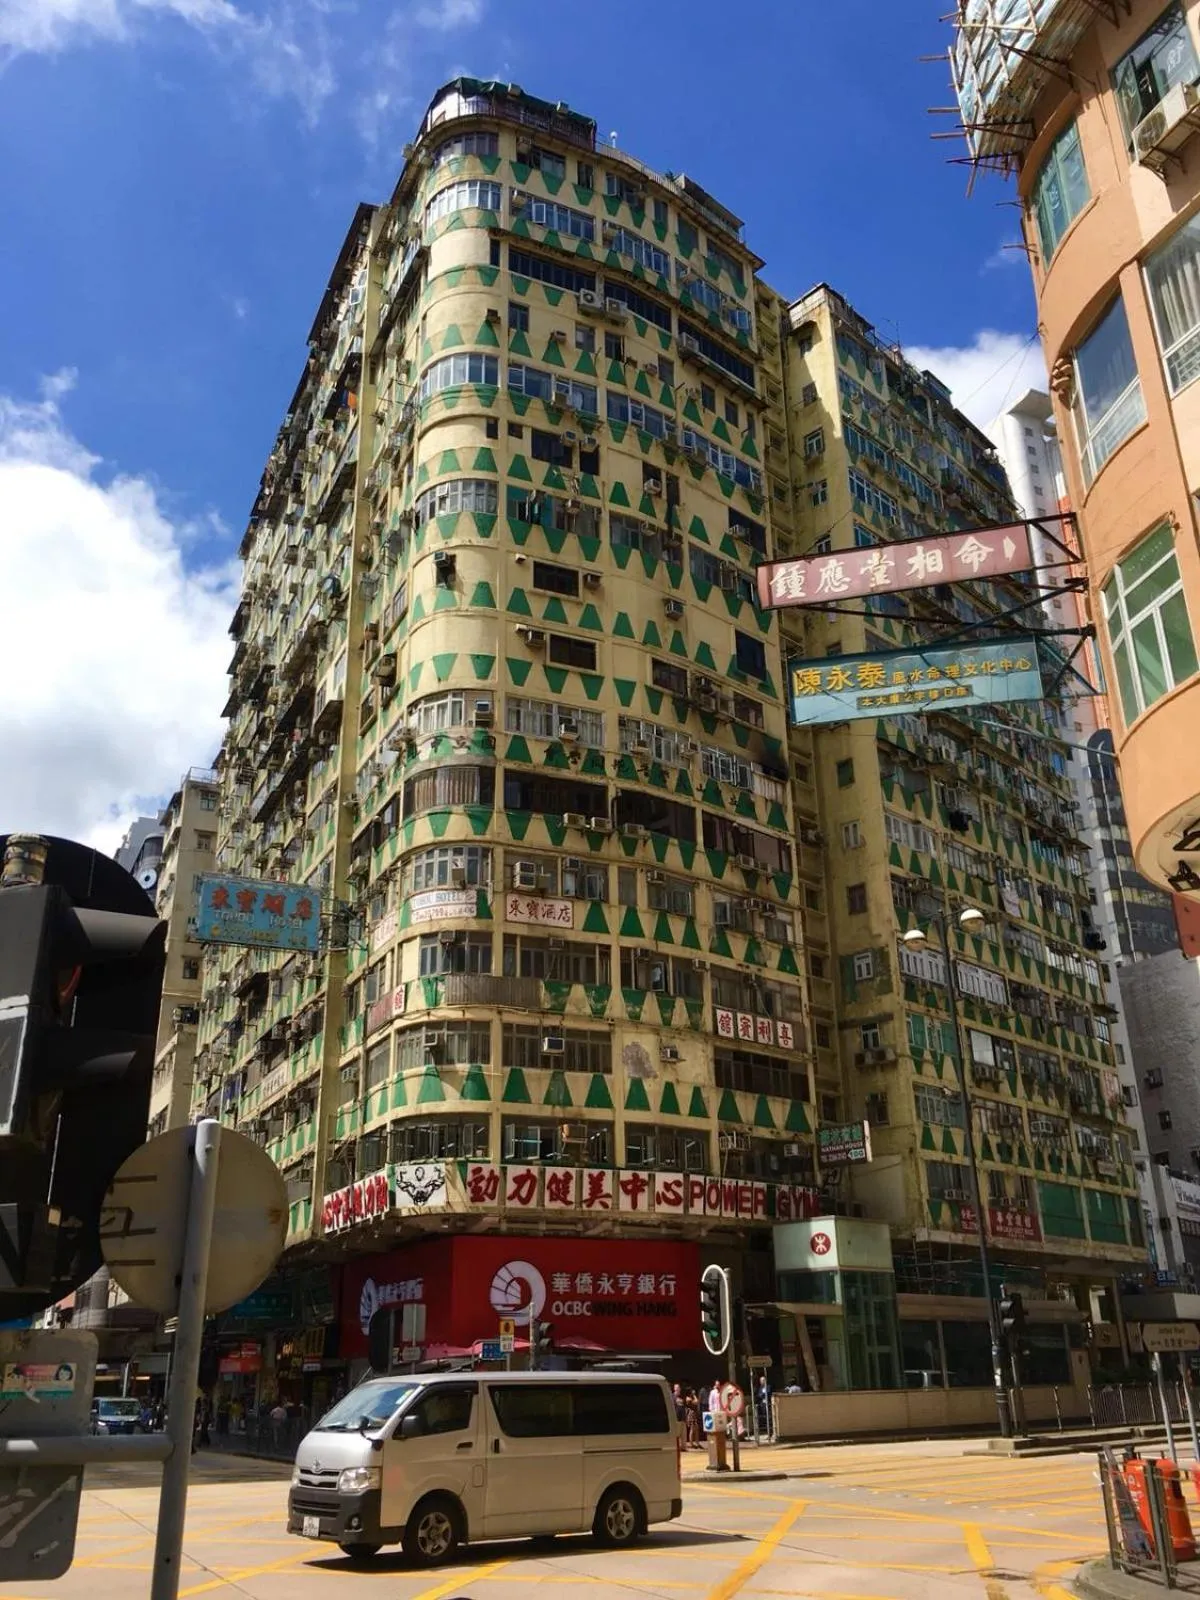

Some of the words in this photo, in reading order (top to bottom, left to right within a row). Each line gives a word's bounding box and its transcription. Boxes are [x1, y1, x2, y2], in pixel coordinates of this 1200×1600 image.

[793, 662, 887, 696] 陳永泰
[509, 898, 571, 922] 東寶酒店
[689, 1179, 767, 1214] POWER
[776, 1189, 821, 1219] GYM
[551, 1272, 677, 1297] 華僑永亨銀行
[552, 1301, 592, 1316] OCBC
[593, 1302, 632, 1317] WING
[637, 1303, 677, 1318] HANG
